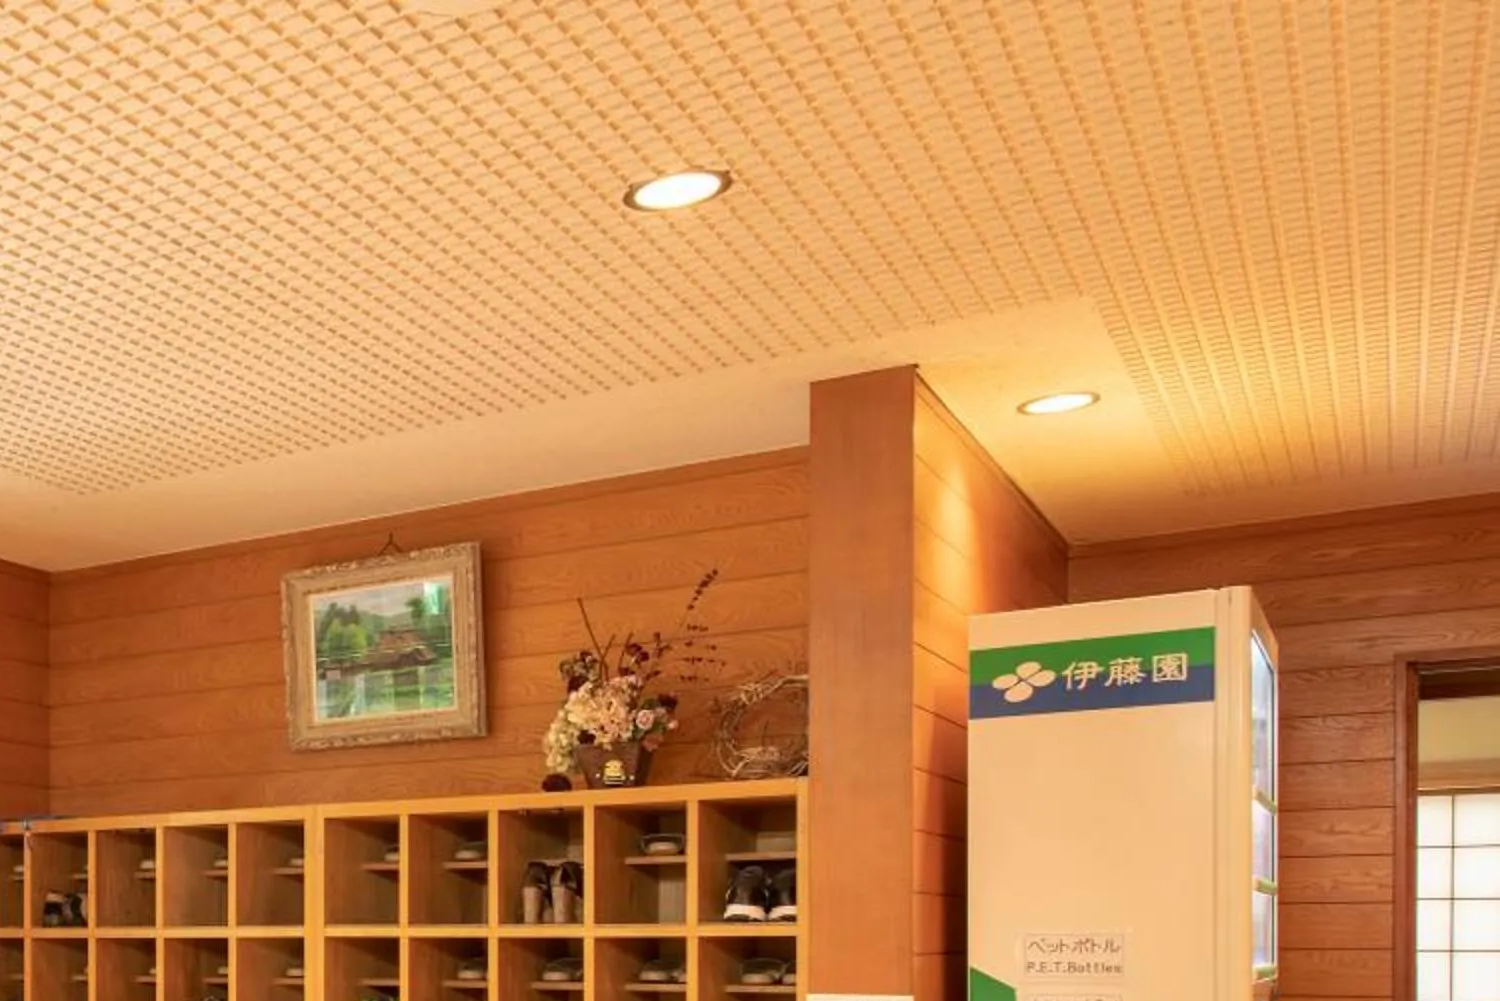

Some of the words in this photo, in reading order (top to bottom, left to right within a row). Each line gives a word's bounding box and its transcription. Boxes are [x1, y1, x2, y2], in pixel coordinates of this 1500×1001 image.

[1062, 653, 1188, 690] 伊藤園
[1027, 938, 1121, 953] ペットボトル
